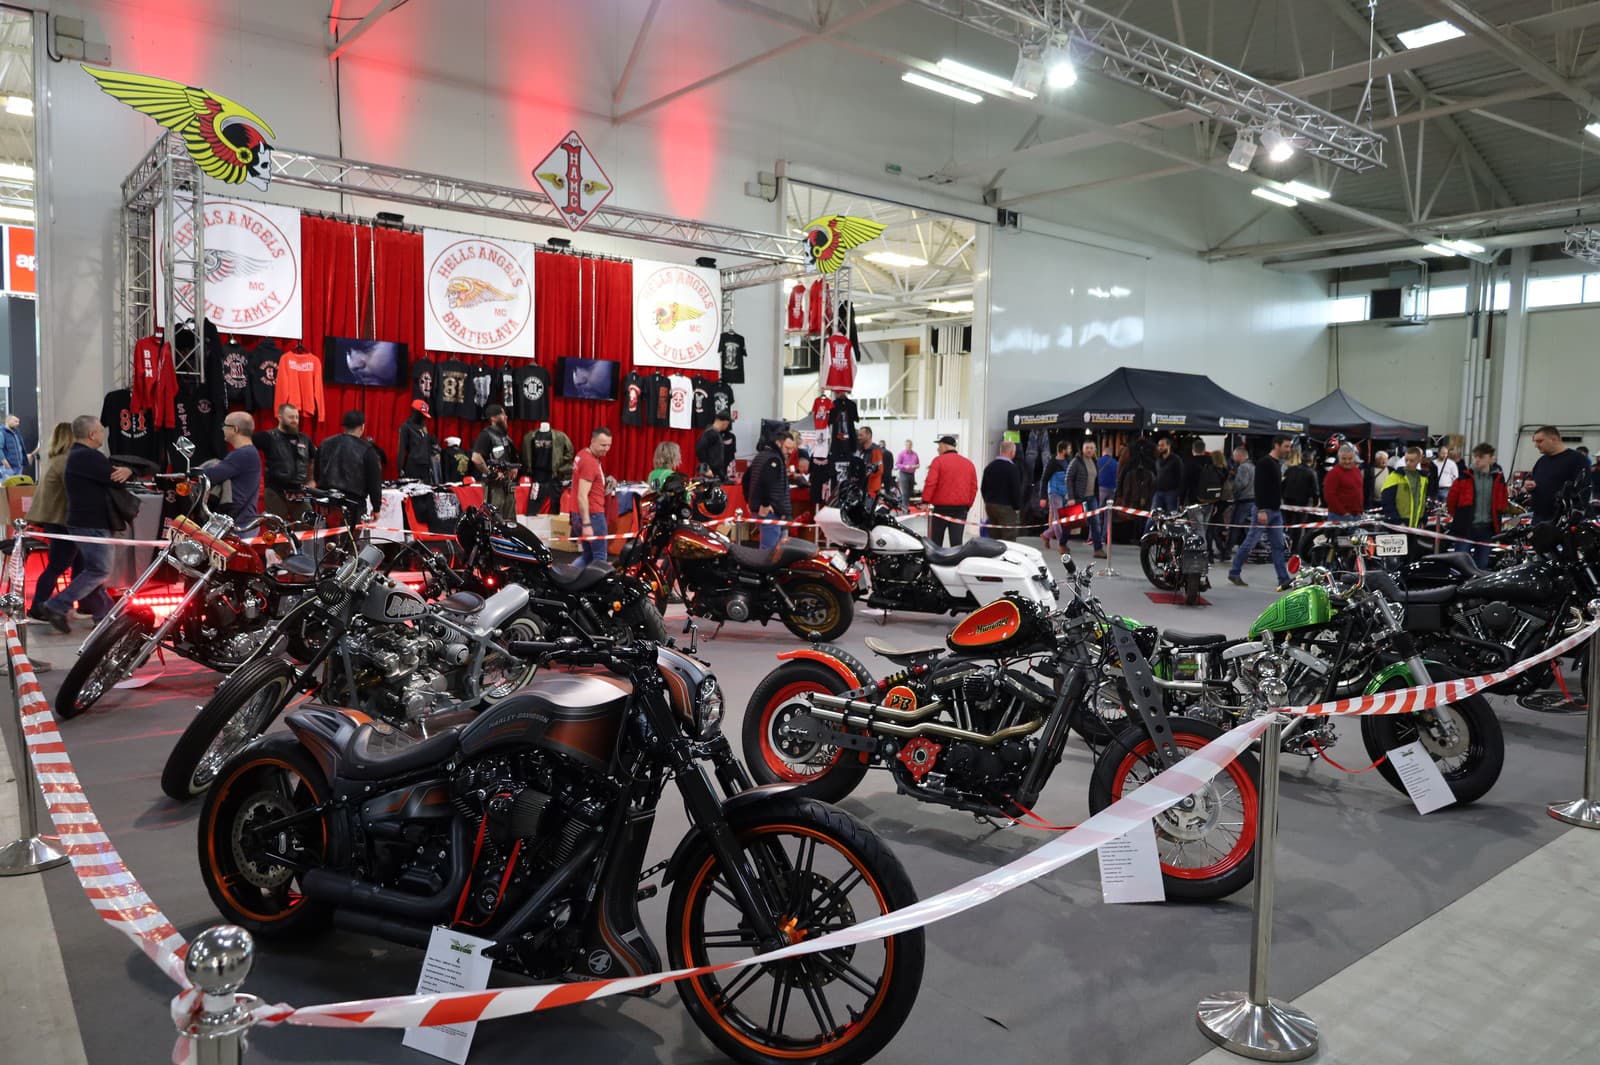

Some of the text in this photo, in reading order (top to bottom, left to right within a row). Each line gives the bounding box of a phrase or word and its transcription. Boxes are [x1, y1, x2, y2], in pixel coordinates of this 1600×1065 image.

[569, 152, 579, 208] HAMC
[226, 211, 286, 259] ANGELS
[437, 245, 523, 288] HELLS ANGELS
[248, 281, 265, 291] MC
[677, 271, 714, 310] ANGELS
[231, 291, 282, 323] ZAMKY
[494, 307, 507, 317] MC
[442, 311, 519, 345] BRATISLAVA
